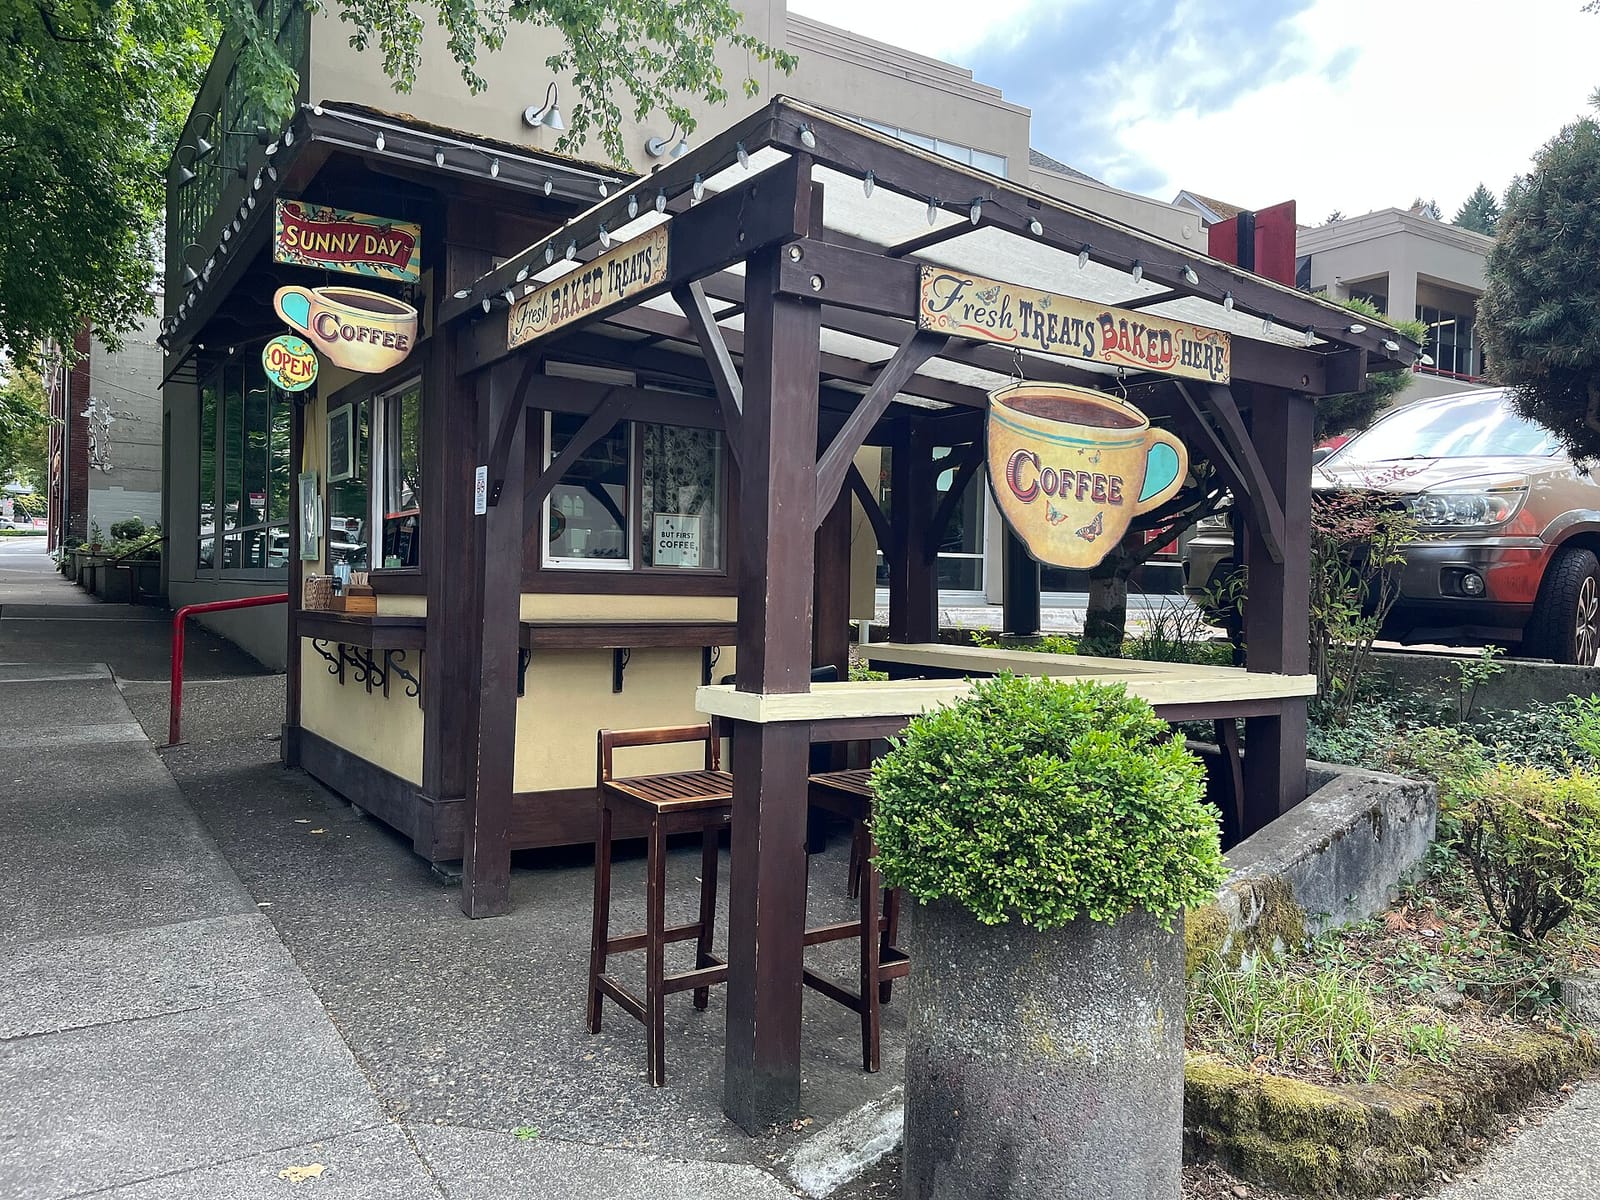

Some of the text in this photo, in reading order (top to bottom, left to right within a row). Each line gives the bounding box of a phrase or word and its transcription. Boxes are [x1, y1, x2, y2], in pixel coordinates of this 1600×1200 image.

[286, 225, 402, 257] SUNNY DAY
[515, 246, 653, 335] Fresh BAKED TREATS
[312, 311, 409, 351] COFFEE
[928, 274, 1224, 380] Fresh TREATS BAKED HERE
[270, 348, 312, 377] OPEN
[1006, 449, 1124, 505] COFFEE
